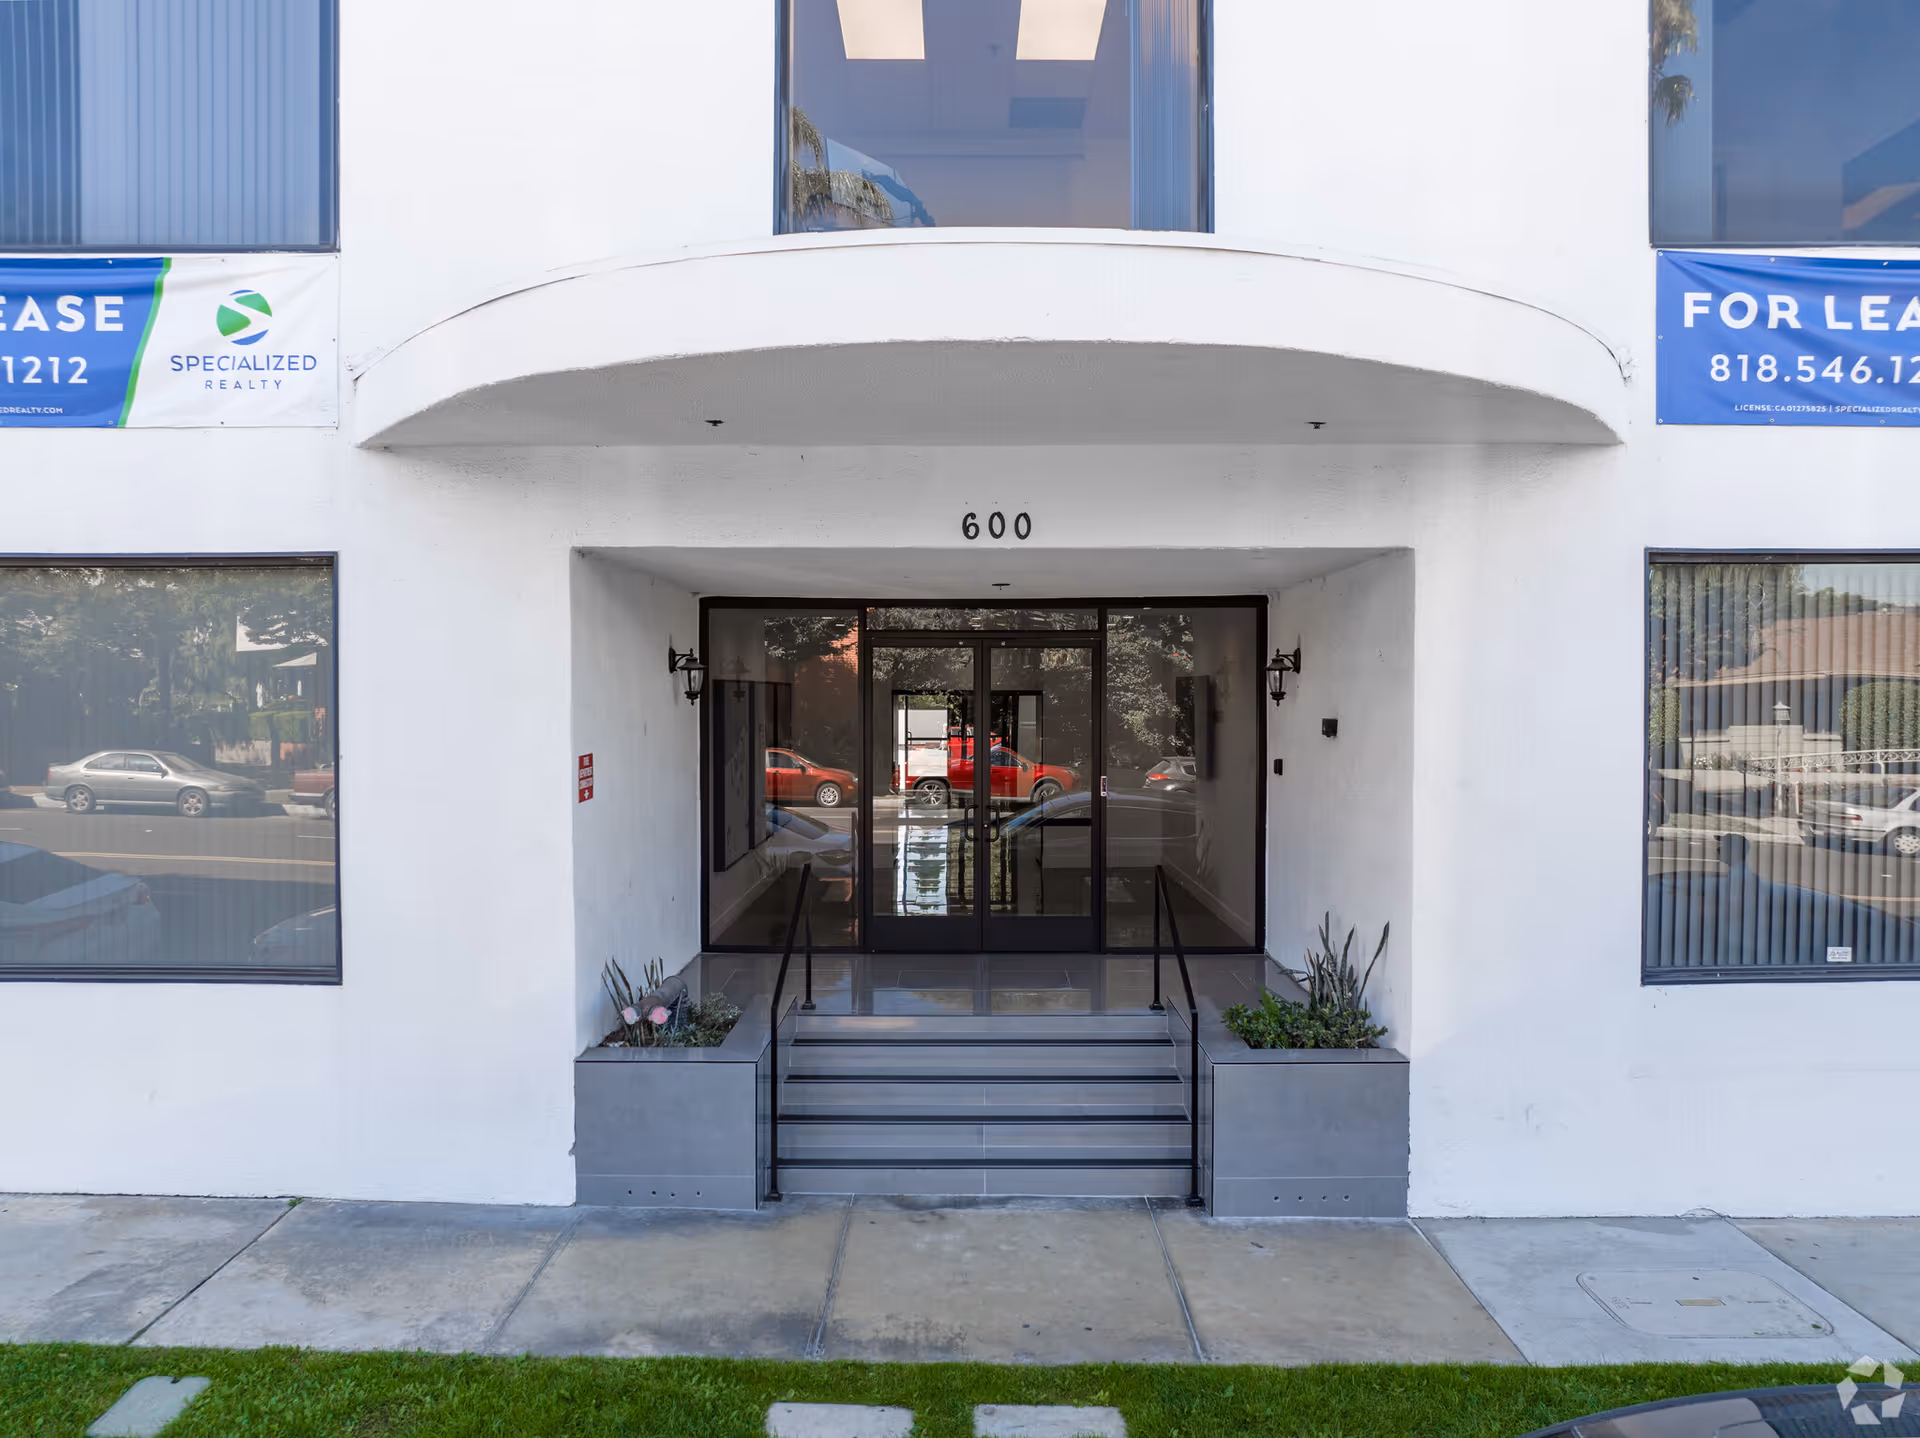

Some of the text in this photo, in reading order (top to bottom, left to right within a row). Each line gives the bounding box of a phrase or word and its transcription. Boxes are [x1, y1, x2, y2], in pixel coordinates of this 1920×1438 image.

[0, 294, 124, 332] ASE
[1683, 292, 1802, 330] FOR
[1, 356, 88, 384] 1212
[170, 354, 317, 372] SPECIALIZED
[204, 379, 282, 390] REALTY
[962, 511, 1031, 540] 600
